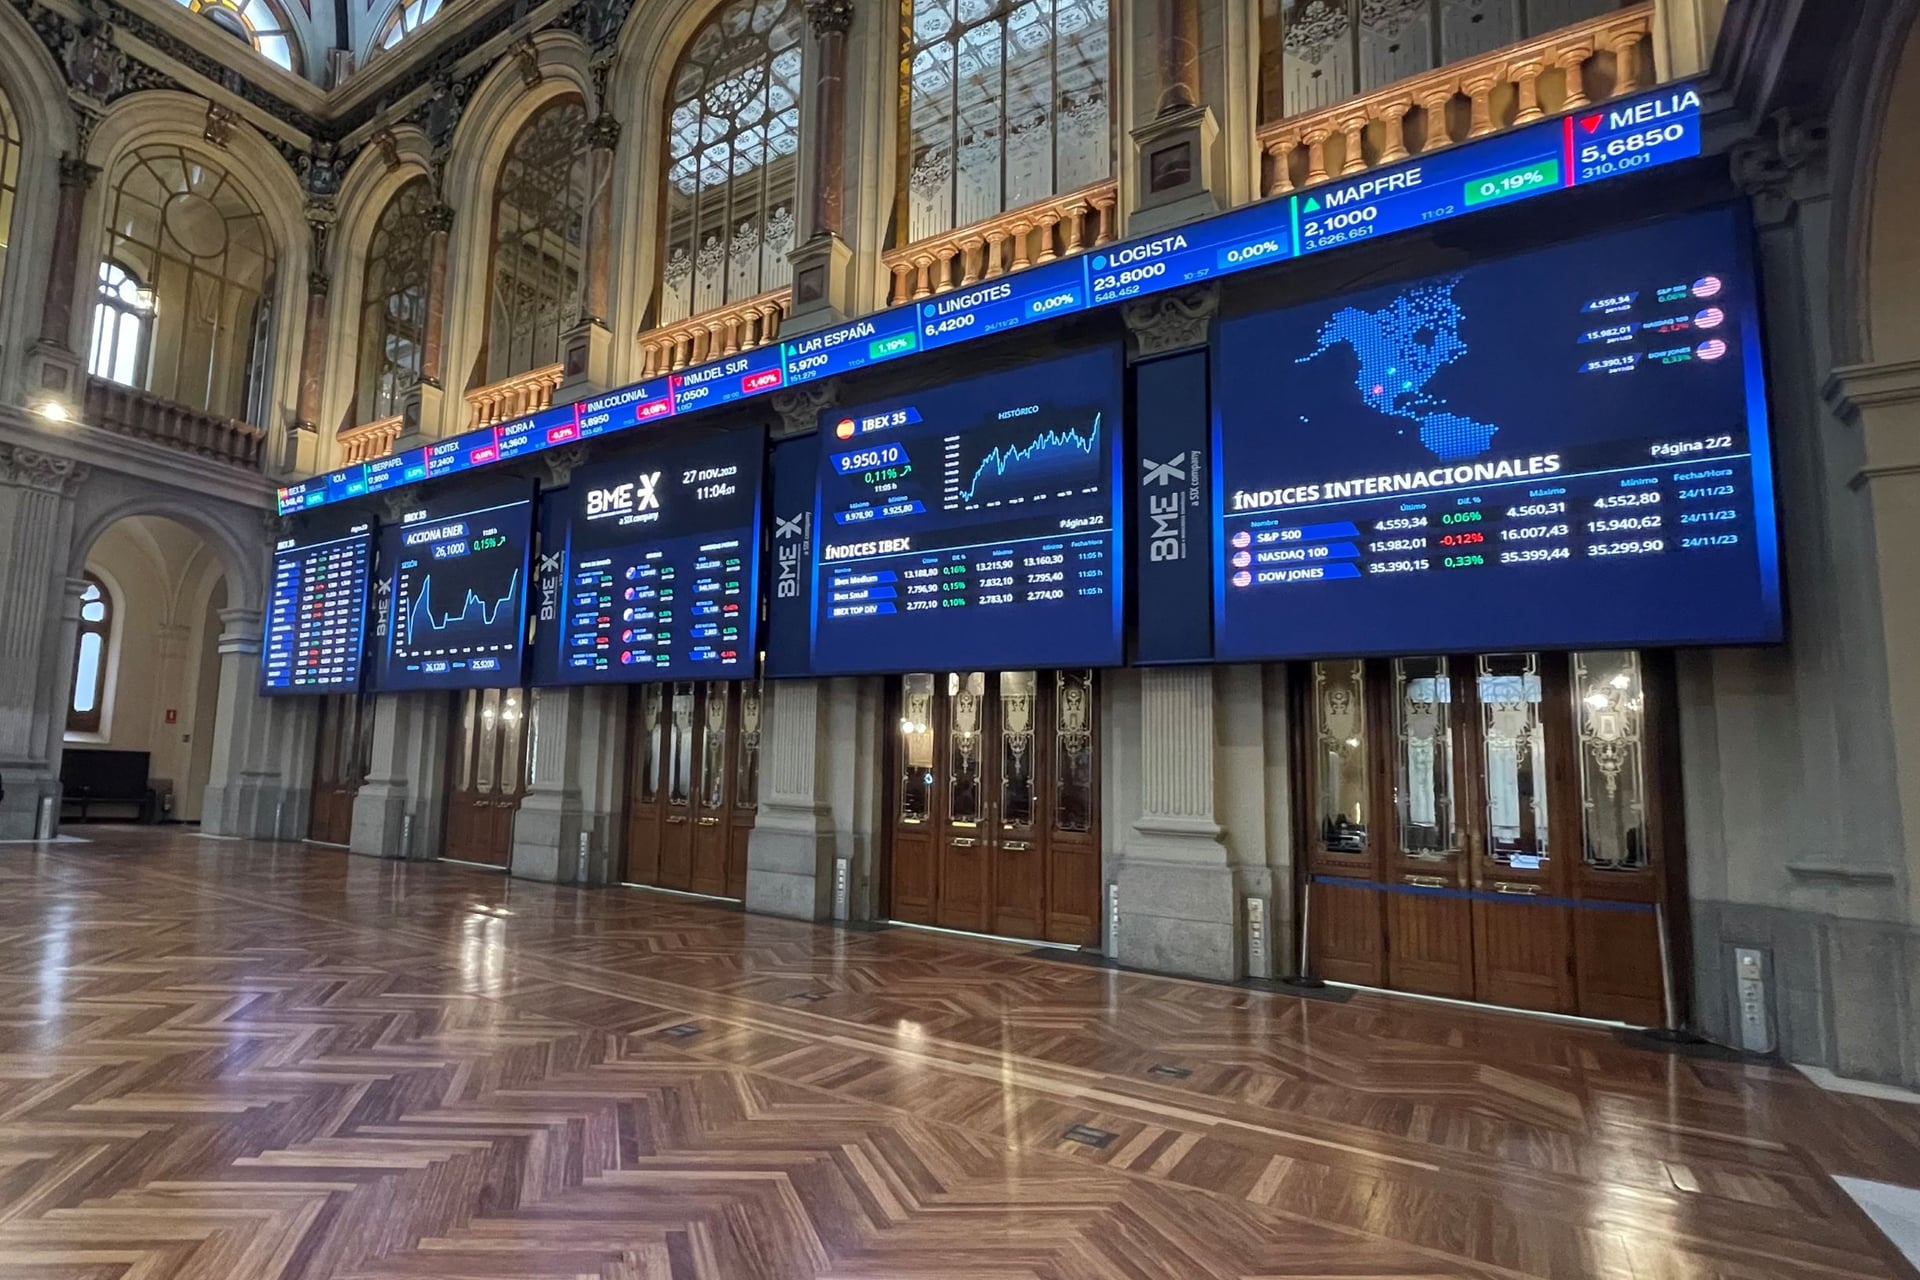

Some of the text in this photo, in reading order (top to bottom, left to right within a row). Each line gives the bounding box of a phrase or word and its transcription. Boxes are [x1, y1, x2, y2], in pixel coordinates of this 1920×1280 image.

[1609, 90, 1700, 131] MELIA
[1580, 123, 1684, 164] 5,6850
[1582, 152, 1652, 180] 310.001
[1325, 168, 1422, 209] MAPFRE
[1480, 170, 1544, 197] 0,19%
[1304, 206, 1378, 238] 2,1000
[1305, 225, 1374, 251] 3.626.651
[1110, 234, 1188, 268] LOGISTA
[1227, 240, 1278, 262] 0,00%
[1094, 262, 1166, 292] 23,8000
[938, 282, 1011, 315] LINGOTES
[1032, 293, 1074, 312] 0,00%
[925, 314, 974, 336] 6,4200
[798, 322, 876, 355] LAR ESPAÑA
[878, 338, 907, 354] 1,19%
[726, 359, 748, 374] SUR
[789, 354, 828, 373] 5,9700
[675, 387, 709, 403] 7,0500
[862, 412, 906, 432] IBEX 35
[998, 405, 1039, 420] HISTÓRICO
[505, 420, 535, 436] INDRA A
[434, 442, 459, 456] INDITEX
[1651, 436, 1732, 456] Página 2/2
[842, 448, 898, 471] 9.950,10
[683, 470, 697, 484] 27
[865, 468, 897, 484] 0,11%
[1232, 454, 1561, 510] ÍNDICES INTERNACIONALES
[587, 483, 634, 514] BME
[1251, 518, 1279, 528] Nombre
[1400, 502, 1426, 512] Último
[1529, 487, 1566, 498] Máximo
[1620, 476, 1659, 488] Mínimo
[1673, 468, 1733, 482] Fecha/Hora
[1060, 515, 1103, 529] Página 2/2
[1257, 485, 1734, 544] S&P 500 4.559,34 0,06% 4.560,31 4.552,80 24/11/23
[407, 524, 463, 545] ACCIONA ENER
[1150, 492, 1178, 562] BME
[1257, 510, 1736, 563] NASDAQ 100 15.982,01 -0,12% 16.007,43 15.940,62 24/11/23
[435, 542, 465, 558] 26,1000
[474, 538, 496, 551] 0,15%
[825, 537, 910, 560] ÍNDICES IBEX
[943, 565, 966, 575] 0,16%
[976, 560, 1013, 572] 13.215,90
[1023, 554, 1063, 567] 13.160,30
[1258, 534, 1738, 583] DOW JONES 35.390,15 0,33% 35.399,44 35.299,90 24/11/23
[778, 544, 796, 598] BME
[943, 582, 966, 591] 0,15%
[1027, 572, 1064, 583] 7.795,40
[541, 577, 554, 620] BME
[942, 598, 966, 607] 0,10%
[1027, 590, 1064, 601] 2.774,00
[377, 600, 388, 636] BME
